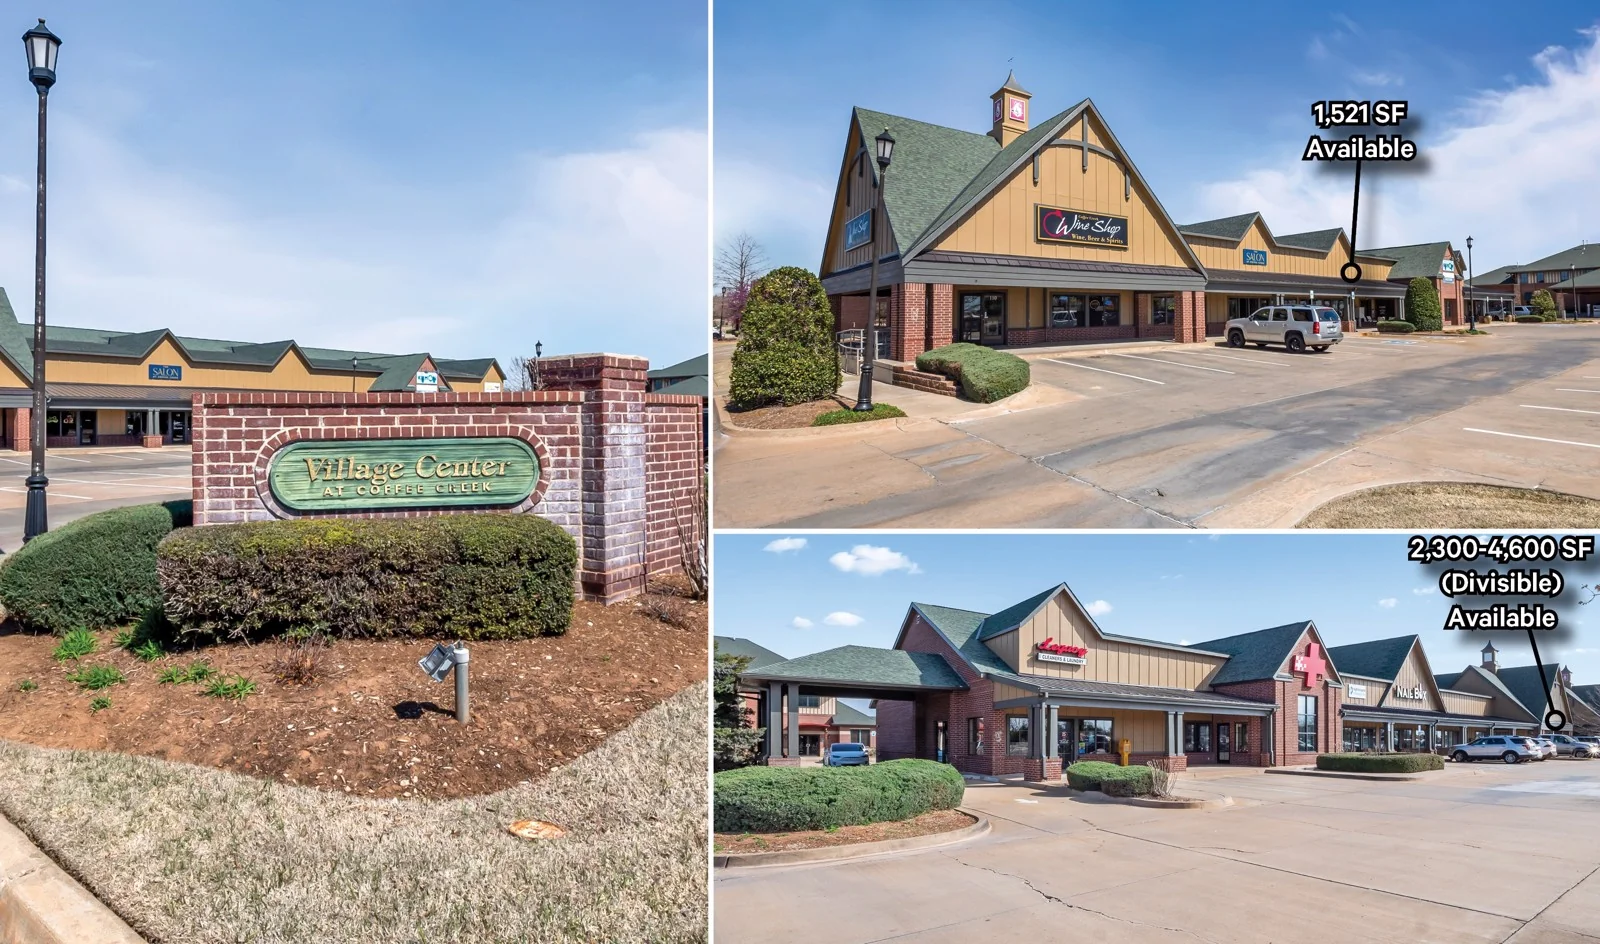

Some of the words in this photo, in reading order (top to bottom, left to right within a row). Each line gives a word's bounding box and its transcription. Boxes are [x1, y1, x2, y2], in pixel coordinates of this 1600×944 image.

[1055, 214, 1090, 235] Wine
[1091, 217, 1121, 238] Shop
[1071, 233, 1087, 241] Wine,
[1246, 251, 1265, 262] SALON
[152, 367, 179, 377] SALON
[303, 455, 405, 486] Village
[415, 455, 513, 479] Center
[322, 485, 345, 497] AT
[356, 483, 425, 496] COFFEE
[435, 481, 493, 494] CREEK
[1039, 638, 1088, 657] Legacy
[1397, 685, 1413, 698] NAIL
